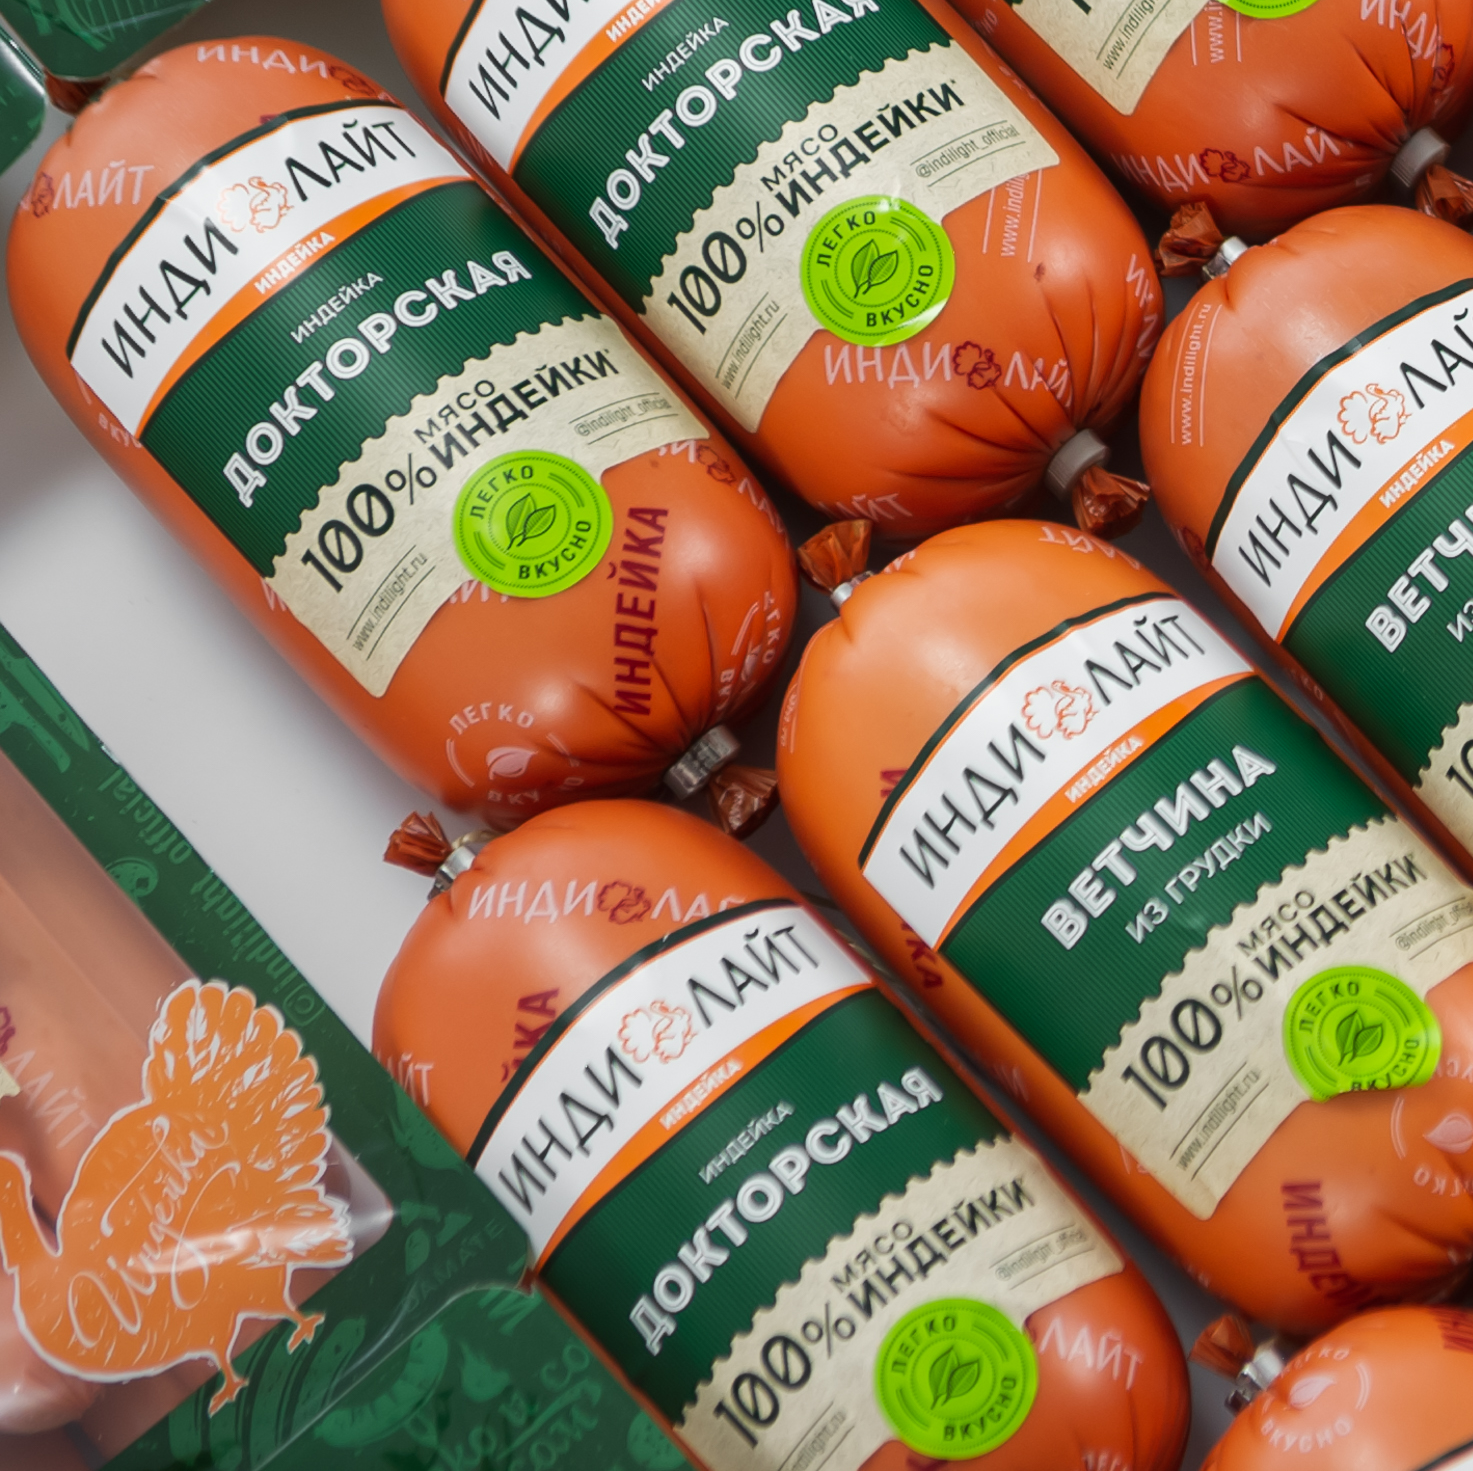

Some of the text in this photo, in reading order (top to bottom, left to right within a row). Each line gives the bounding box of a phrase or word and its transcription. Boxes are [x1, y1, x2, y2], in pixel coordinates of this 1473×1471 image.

[782, 83, 965, 215] ИНДЕЙКИ
[290, 272, 384, 345] ИНДЕЙКА
[667, 201, 785, 335] 100%
[865, 265, 934, 328] ВКУСНО
[222, 250, 532, 507] ДОКТОРСКАЯ
[413, 379, 495, 445] МЯСО
[429, 351, 619, 470] ИНДЕЙКИ
[301, 453, 438, 592] 100%
[469, 464, 535, 520] ЛЕГКО
[517, 518, 592, 580] ВКУСНО
[353, 552, 428, 651] www.indilight.ru
[613, 507, 669, 717] ИНДЕЙКА
[1040, 745, 1277, 950] ВЕТЧИНА
[1126, 812, 1273, 942] ИЗ ГРУДКИ
[1236, 890, 1314, 957] МЯСО
[1122, 966, 1263, 1111] 100%
[699, 1102, 793, 1183] ИНДЕЙКА
[629, 1067, 942, 1355] ДОКТОРСКАЯ
[848, 1178, 1037, 1319] ИНДЕЙКИ
[714, 1304, 855, 1448] 100%
